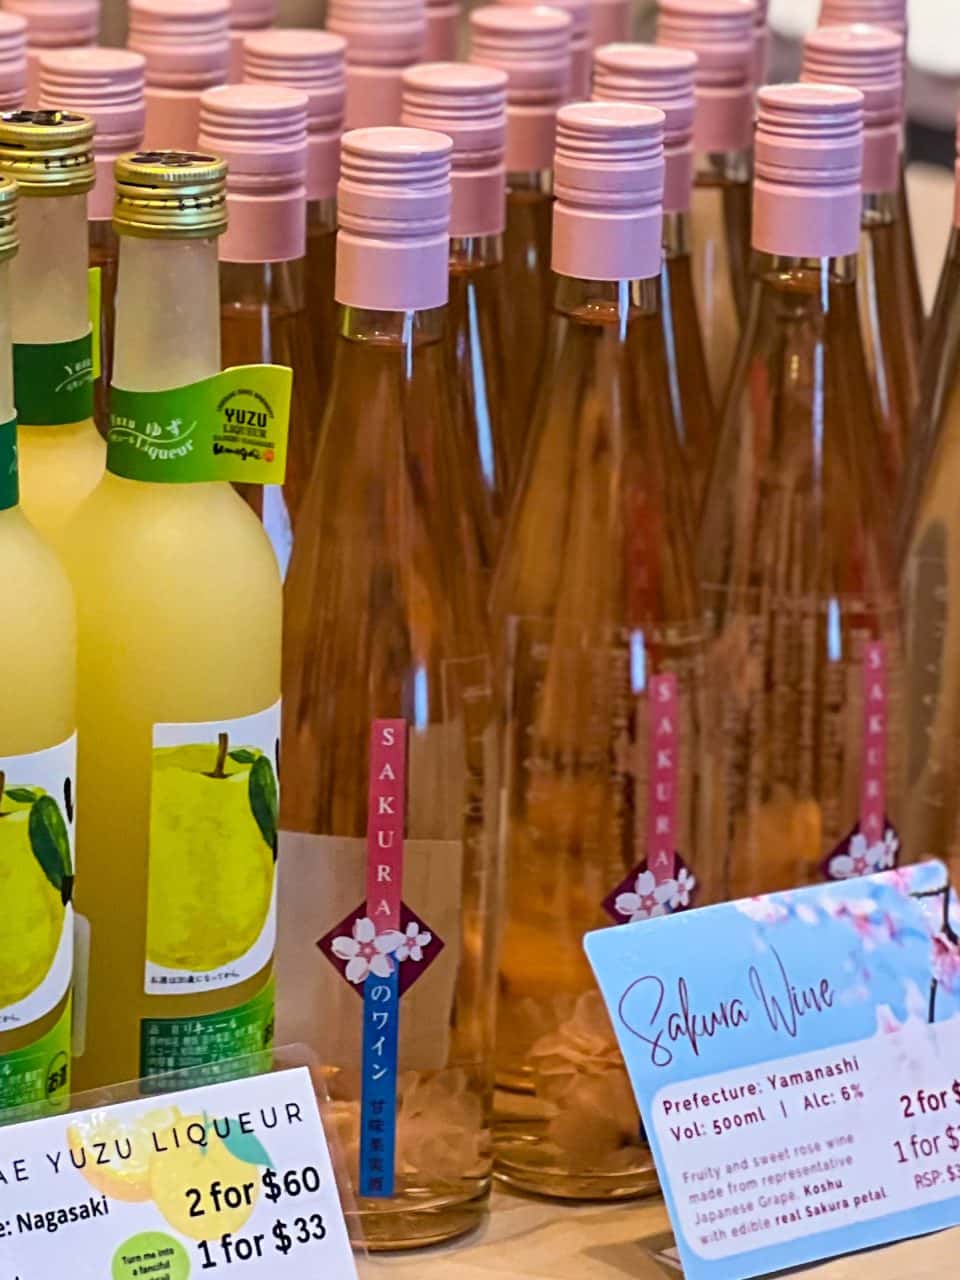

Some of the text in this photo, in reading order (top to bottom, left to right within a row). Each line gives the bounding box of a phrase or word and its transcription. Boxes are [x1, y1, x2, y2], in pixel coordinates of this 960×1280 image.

[224, 408, 267, 428] YUZU
[655, 682, 673, 867] SAKURA
[376, 727, 396, 916] SAKURA
[369, 984, 392, 1081] のワイン
[618, 943, 838, 1068] Sakura Wine
[662, 1055, 861, 1116] Prefecture: Yamanashi
[670, 1121, 706, 1143] Vol:
[712, 1105, 767, 1136] 500ml
[802, 1090, 837, 1112] Alc:
[839, 1082, 865, 1102] 6%
[900, 1095, 915, 1118] 2
[917, 1089, 948, 1114] for
[46, 1137, 135, 1175] YUZU
[152, 1101, 304, 1155] LIQUEUR
[682, 1166, 721, 1186] Fruity
[725, 1157, 750, 1176] and
[752, 1147, 791, 1167] sweet
[826, 1132, 856, 1151] wine
[893, 1140, 909, 1164] 1
[910, 1134, 940, 1159] for
[184, 1165, 323, 1218] 2 for $60
[688, 1154, 855, 1205] made from representative
[694, 1201, 756, 1226] Japanese
[802, 1177, 845, 1198] Koshu
[914, 1169, 946, 1190] RSP:
[15, 1194, 111, 1234] Nagasaki
[197, 1213, 328, 1269] 1 for $33
[698, 1185, 888, 1247] with edible real Sakura petal
[143, 1250, 157, 1262] me
